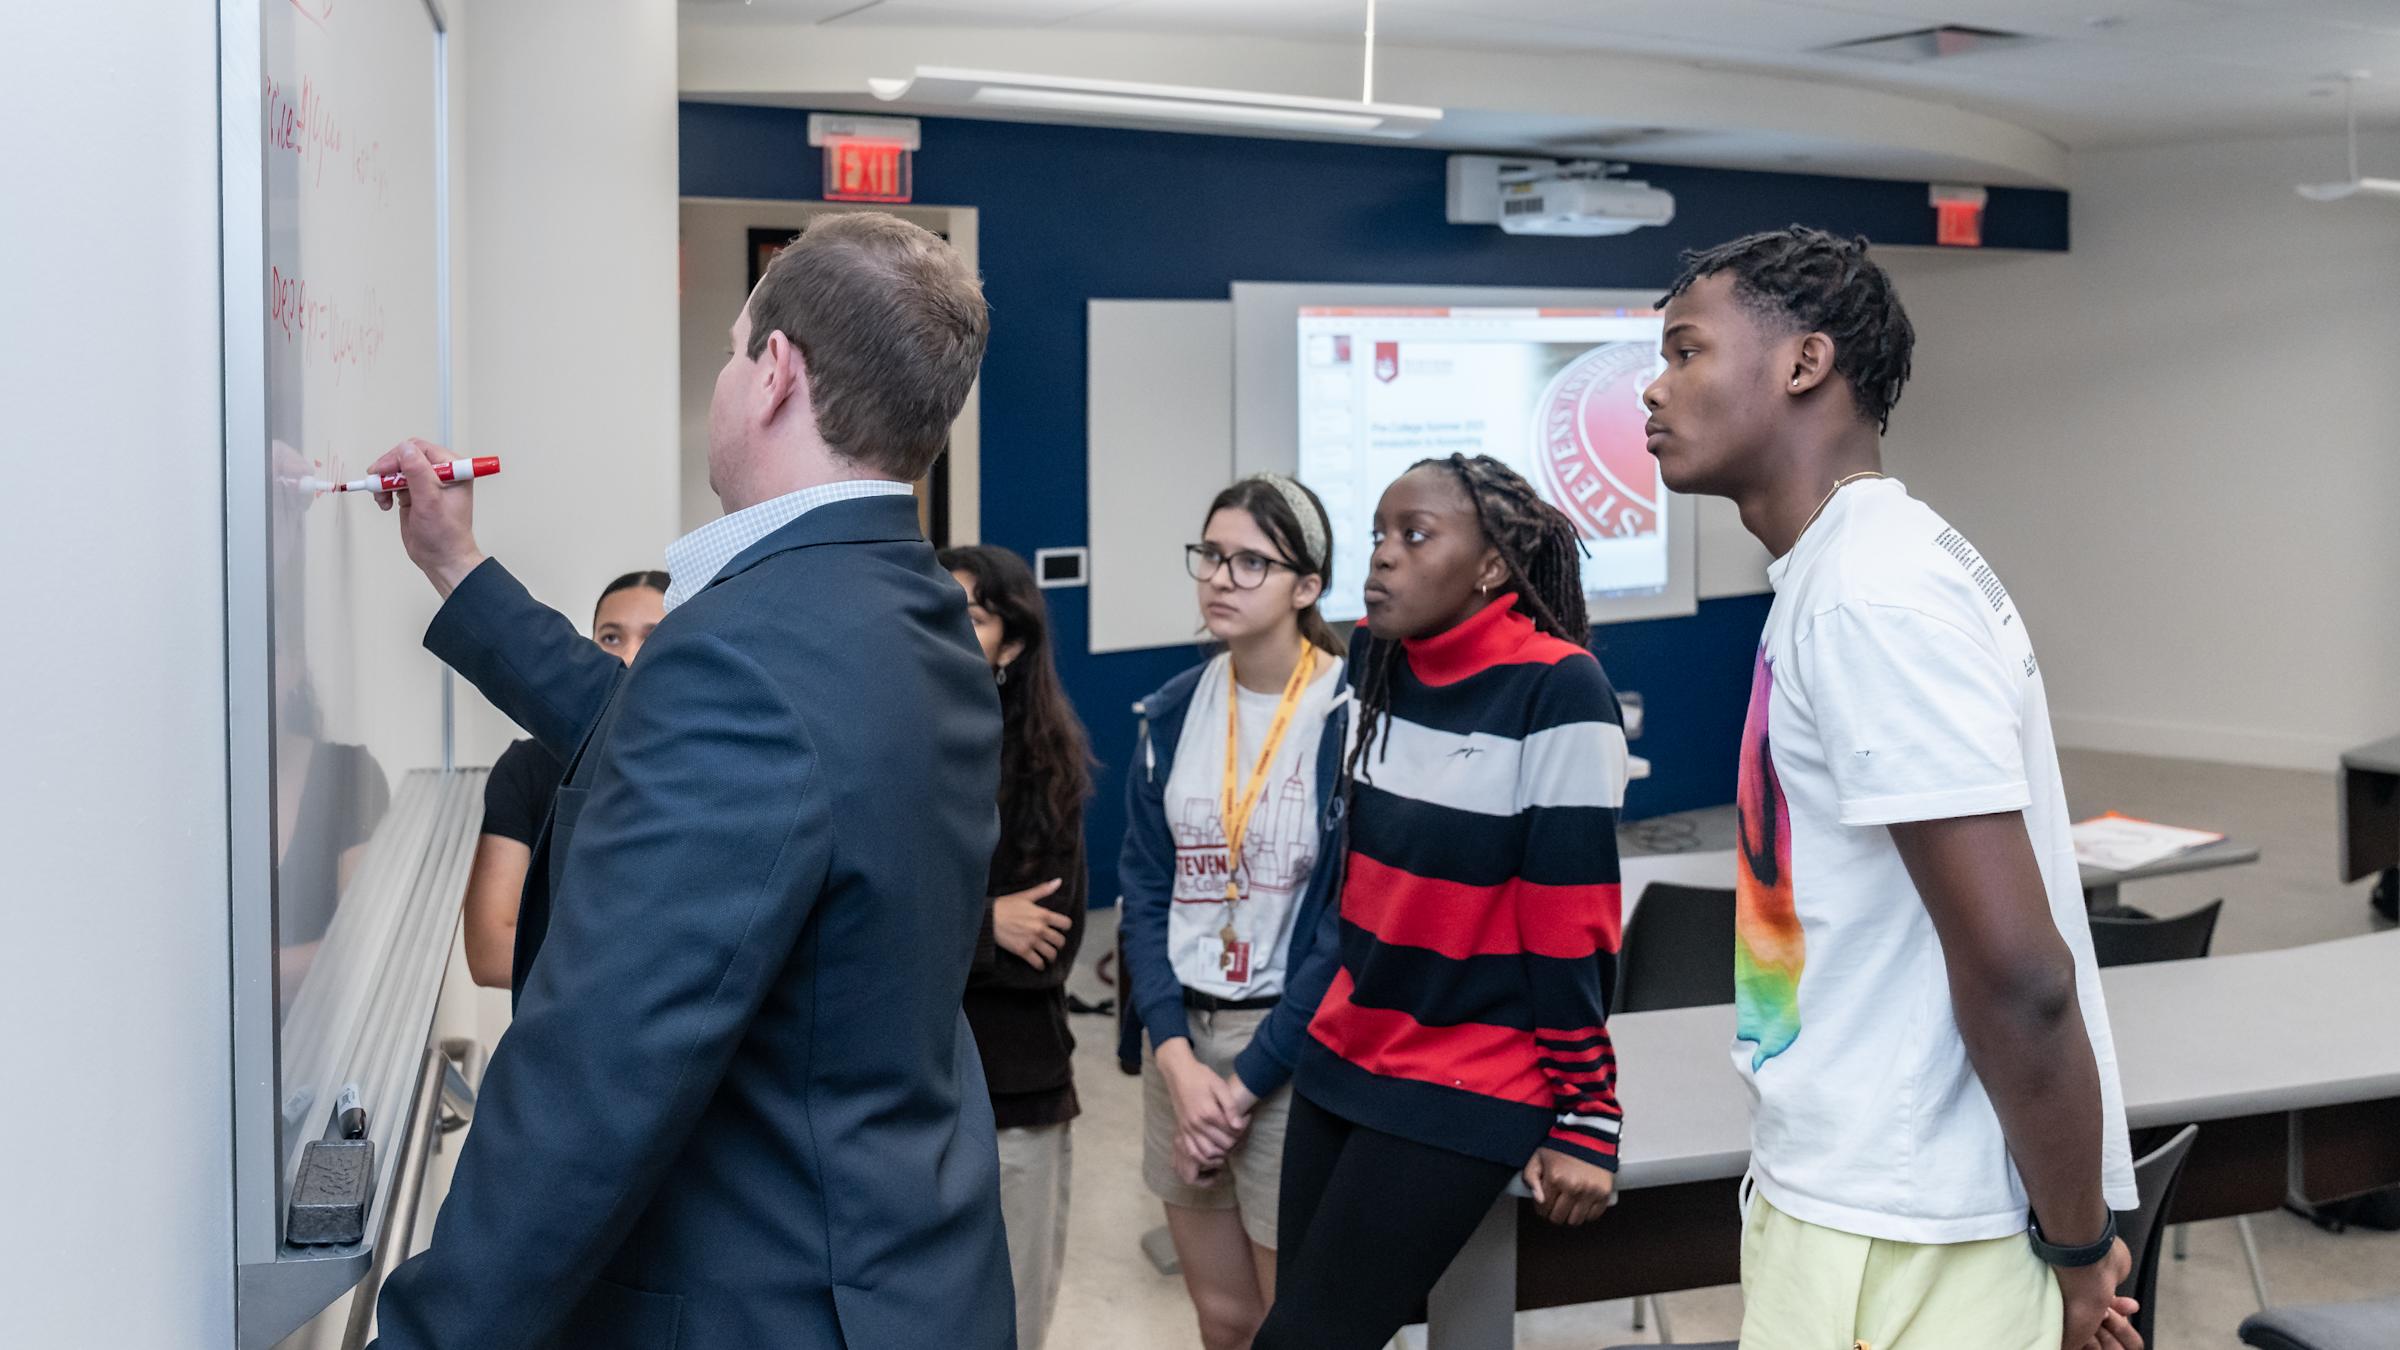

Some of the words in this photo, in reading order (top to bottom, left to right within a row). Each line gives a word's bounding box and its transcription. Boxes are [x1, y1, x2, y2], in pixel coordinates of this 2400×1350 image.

[839, 144, 903, 195] EXIT
[1550, 410, 1643, 536] STEVENS
[1176, 855, 1228, 876] TEVEN
